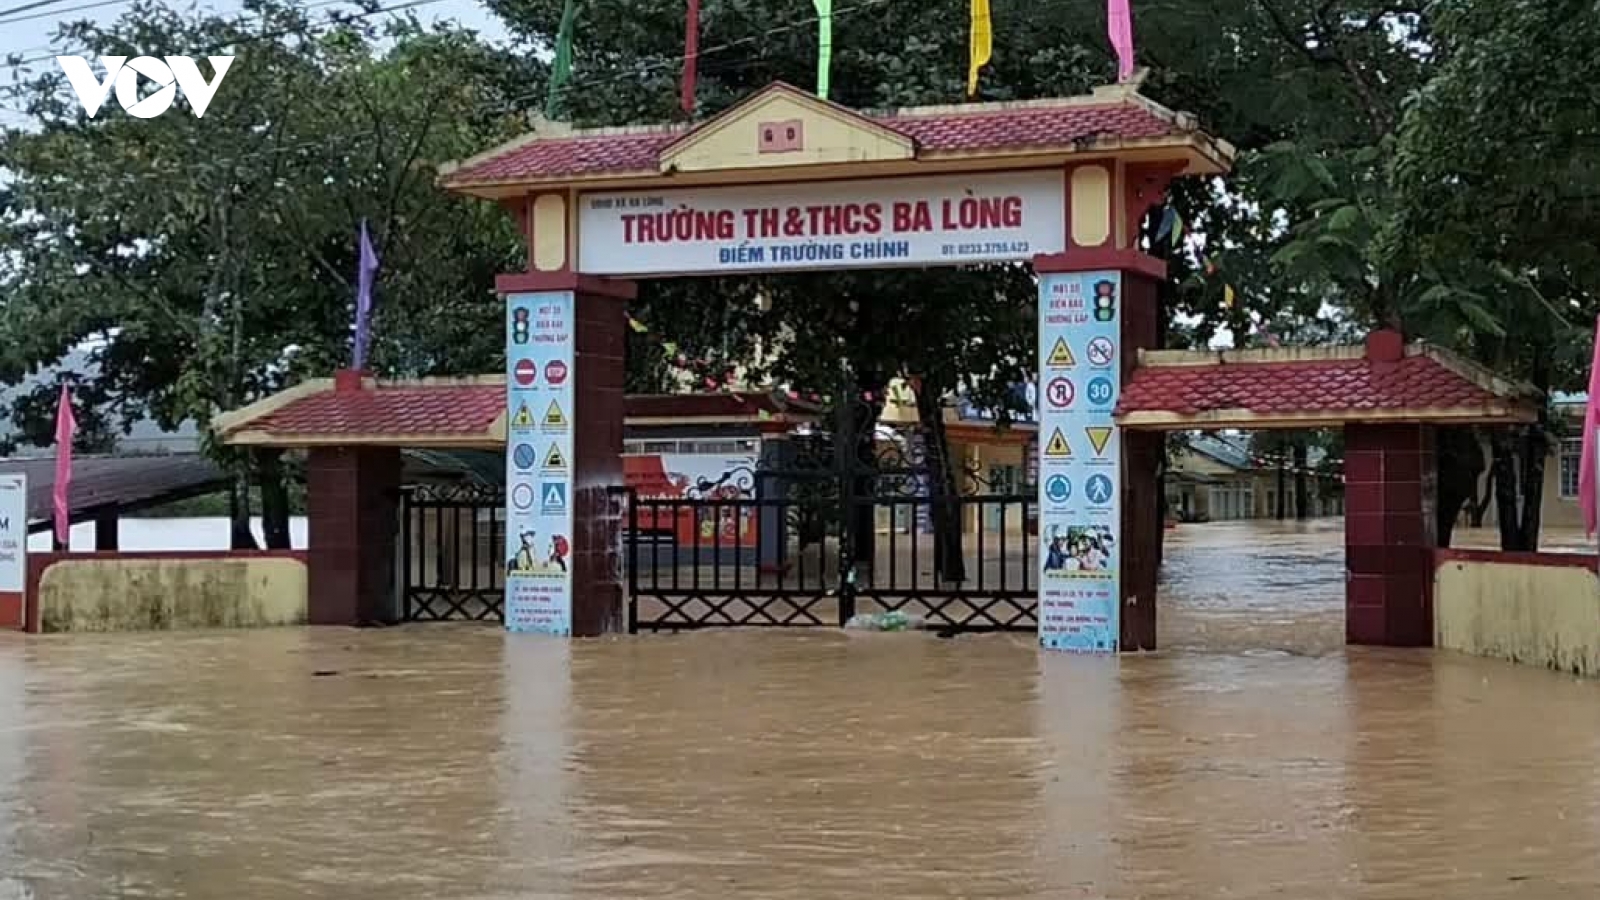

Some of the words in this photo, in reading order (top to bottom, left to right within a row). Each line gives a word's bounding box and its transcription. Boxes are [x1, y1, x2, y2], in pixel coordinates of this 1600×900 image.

[621, 204, 735, 243] TRƯỜNG
[892, 200, 933, 232] BA
[942, 189, 1022, 230] LÒNG
[770, 239, 843, 262] TRƯỜNG
[850, 237, 909, 259] CHÍNH
[1090, 383, 1110, 399] 30
